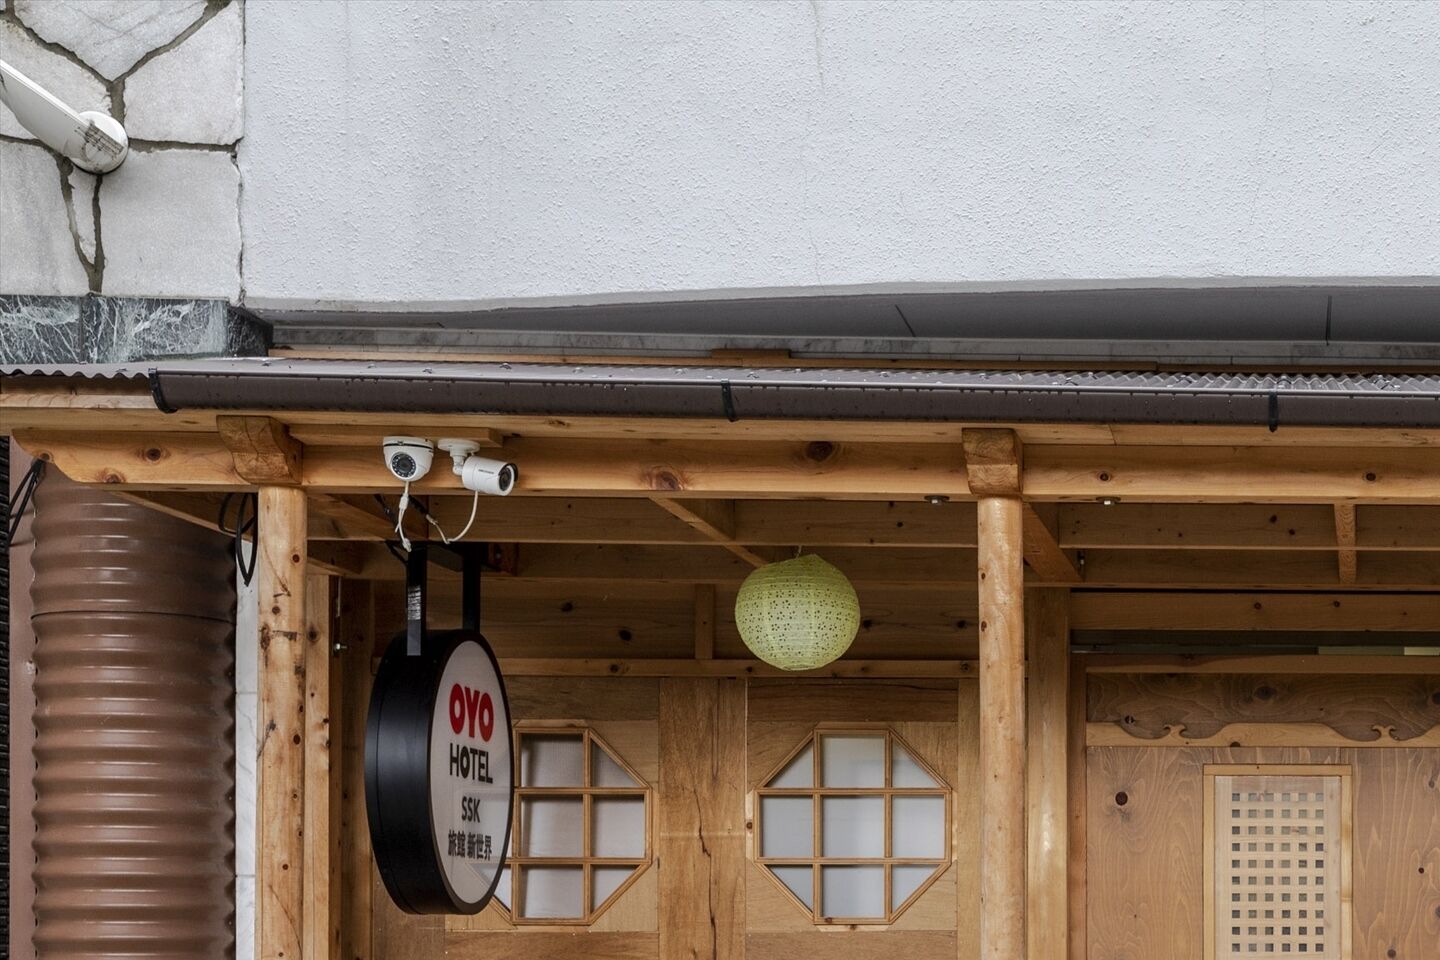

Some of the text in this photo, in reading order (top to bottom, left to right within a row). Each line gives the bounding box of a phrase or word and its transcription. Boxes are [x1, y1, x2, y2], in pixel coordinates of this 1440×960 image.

[449, 683, 494, 742] OYO
[450, 743, 493, 784] HOTEL
[461, 796, 481, 823] SSK
